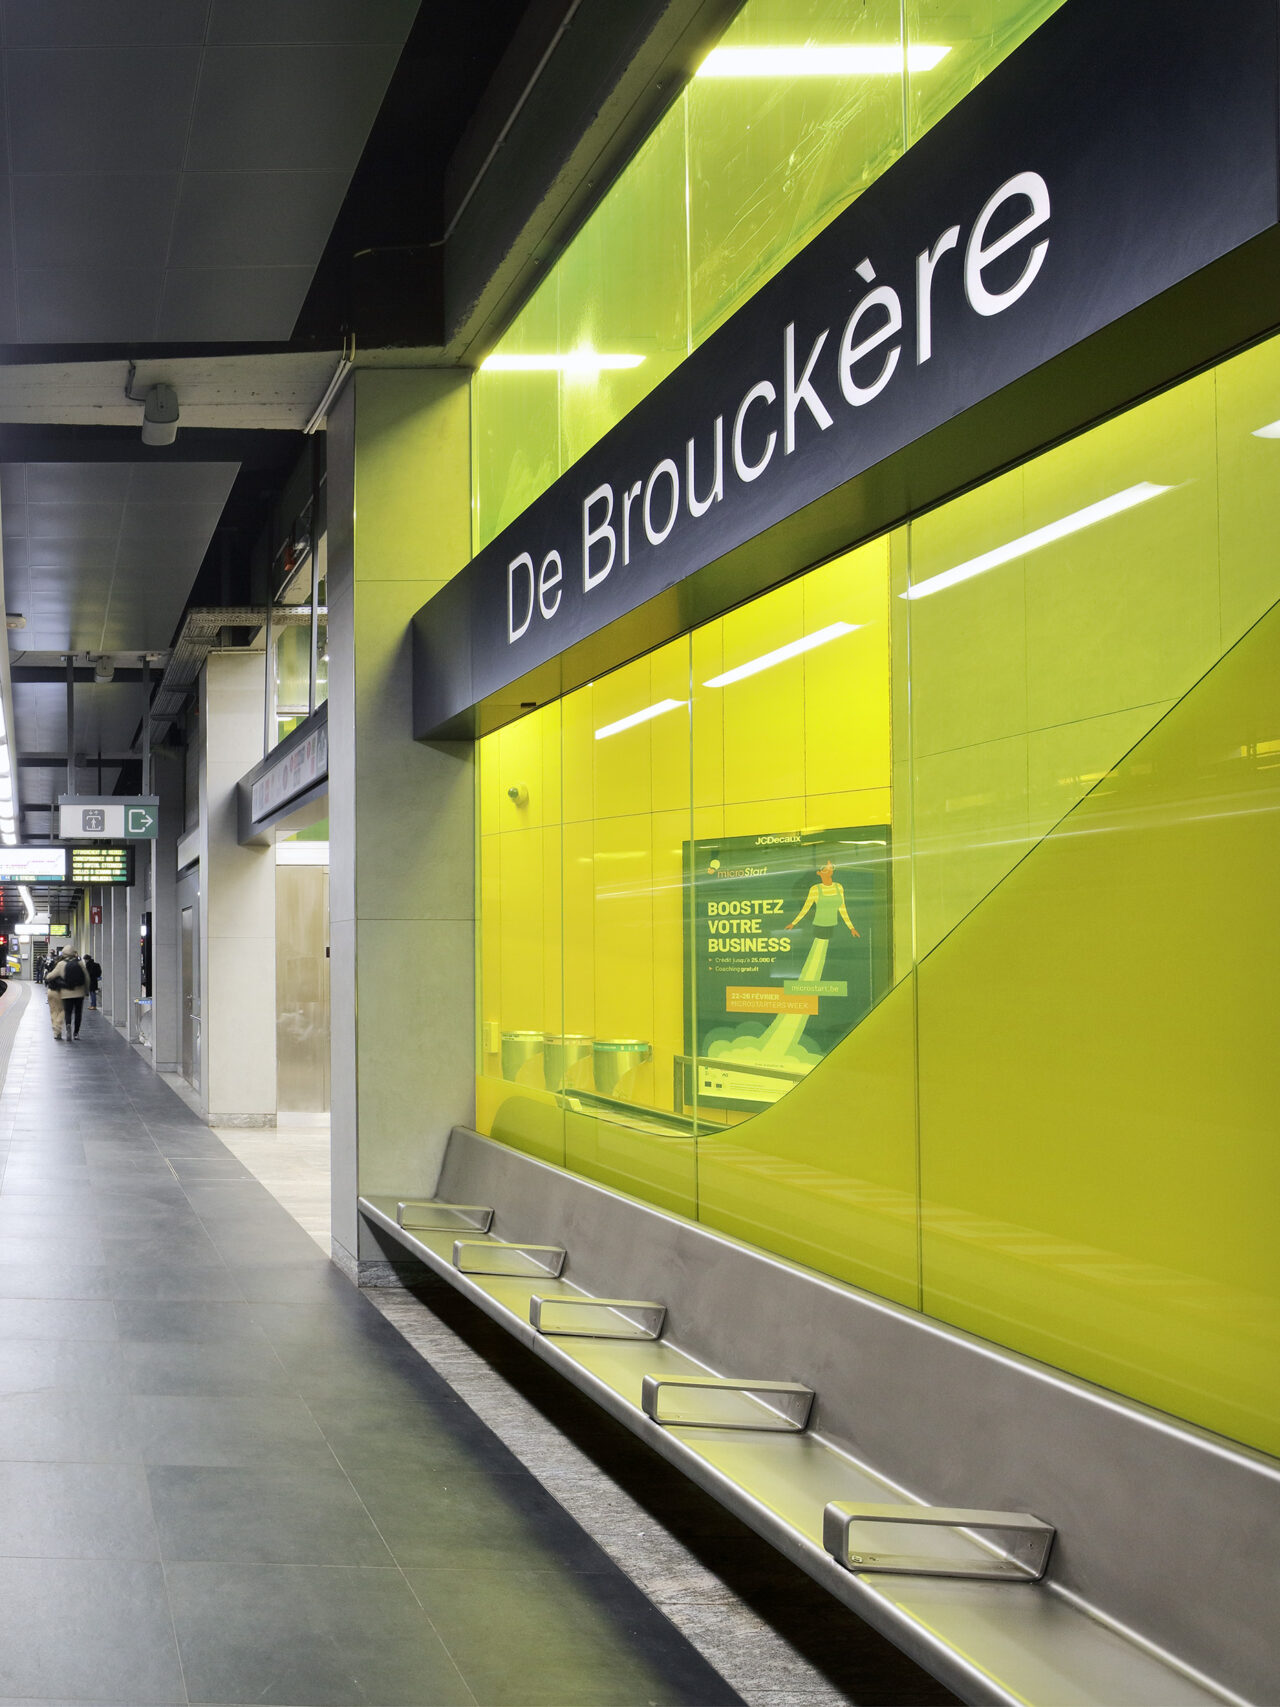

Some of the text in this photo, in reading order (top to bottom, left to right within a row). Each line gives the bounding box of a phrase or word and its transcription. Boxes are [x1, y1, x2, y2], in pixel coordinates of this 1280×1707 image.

[506, 170, 1052, 645] De Brouckère
[755, 835, 801, 846] JCDecaux
[717, 866, 768, 879] microStart
[708, 899, 784, 916] BOOSTEZ
[708, 919, 762, 934] VOTRE
[708, 937, 791, 953] BUSINESS
[791, 984, 839, 993] microstart.be
[751, 992, 780, 1001] FÉVRIER
